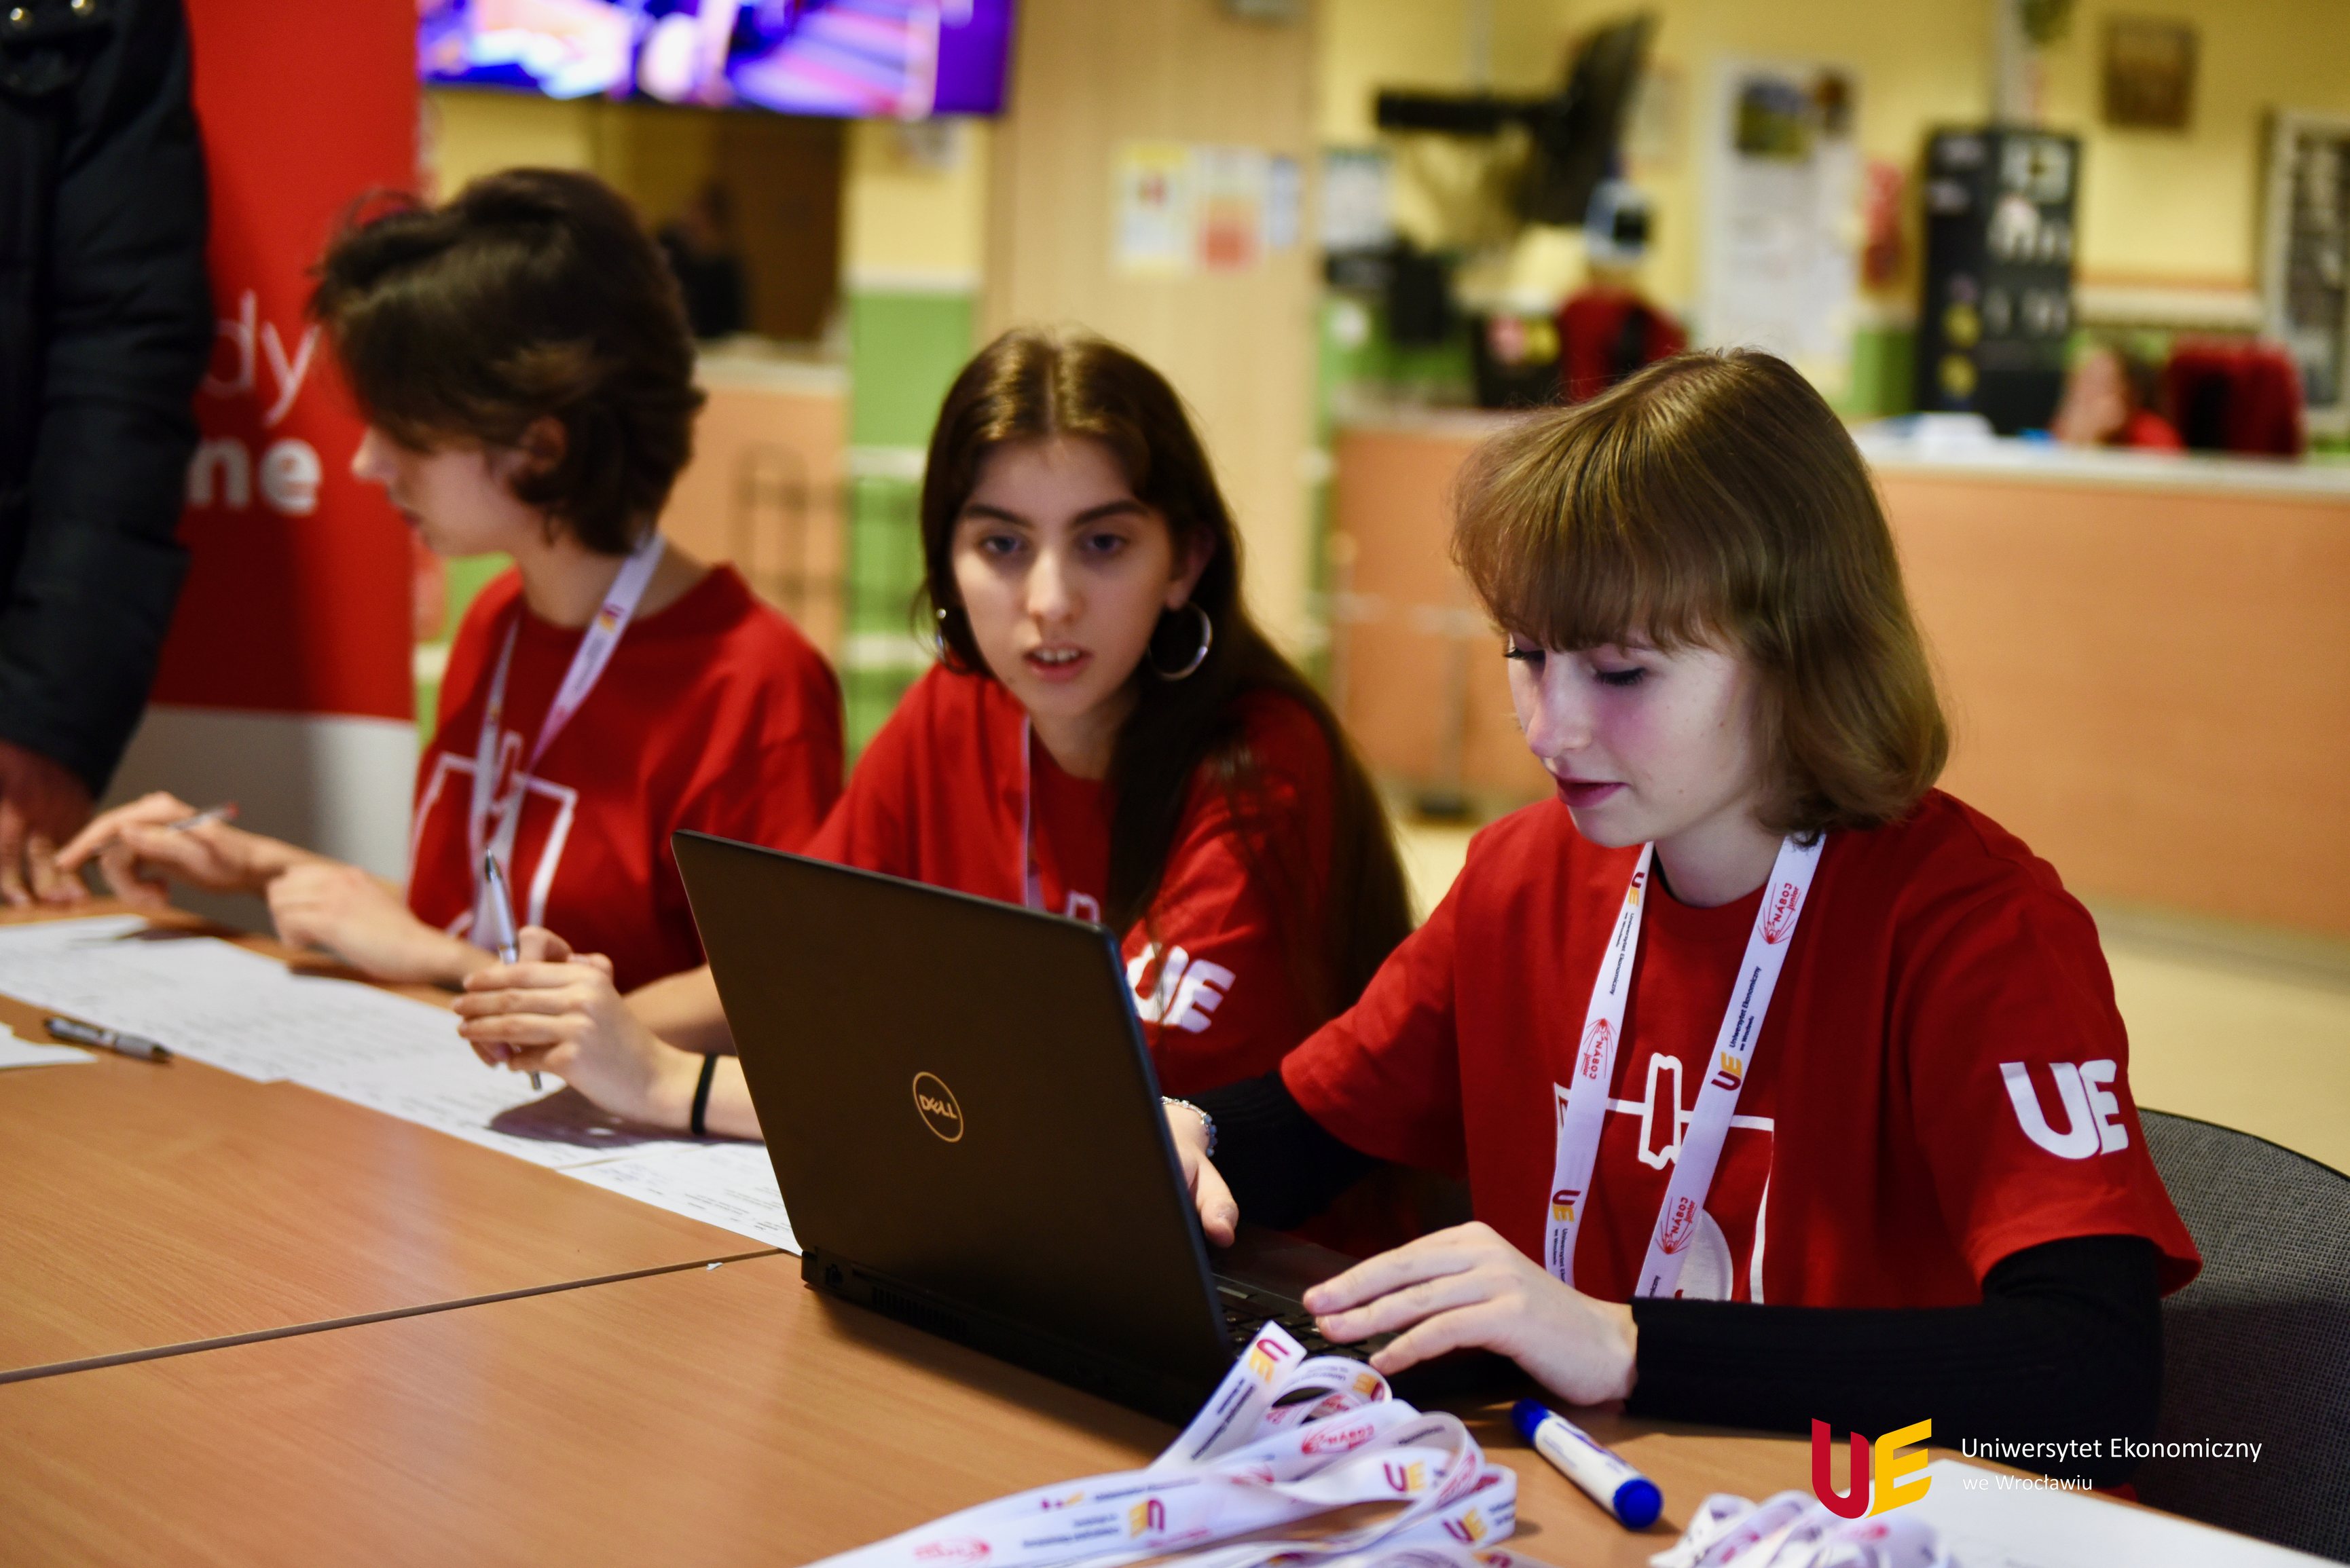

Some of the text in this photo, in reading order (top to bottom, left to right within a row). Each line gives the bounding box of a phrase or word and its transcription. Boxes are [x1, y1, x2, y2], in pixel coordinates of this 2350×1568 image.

[1628, 872, 1645, 906] UE
[1774, 882, 1792, 922] NÁBOJ
[1729, 966, 1762, 1048] Uniwersytet Ekonomiczny
[1590, 1041, 1603, 1079] NÁBOJ
[1711, 1051, 1742, 1091] UE
[919, 1094, 958, 1120] DELL
[1999, 1059, 2129, 1159] UE
[1552, 1189, 1581, 1222] UE
[1671, 1197, 1689, 1233] NÁBOJ
[1383, 1460, 1427, 1493] UE
[1441, 1508, 1488, 1544] UE
